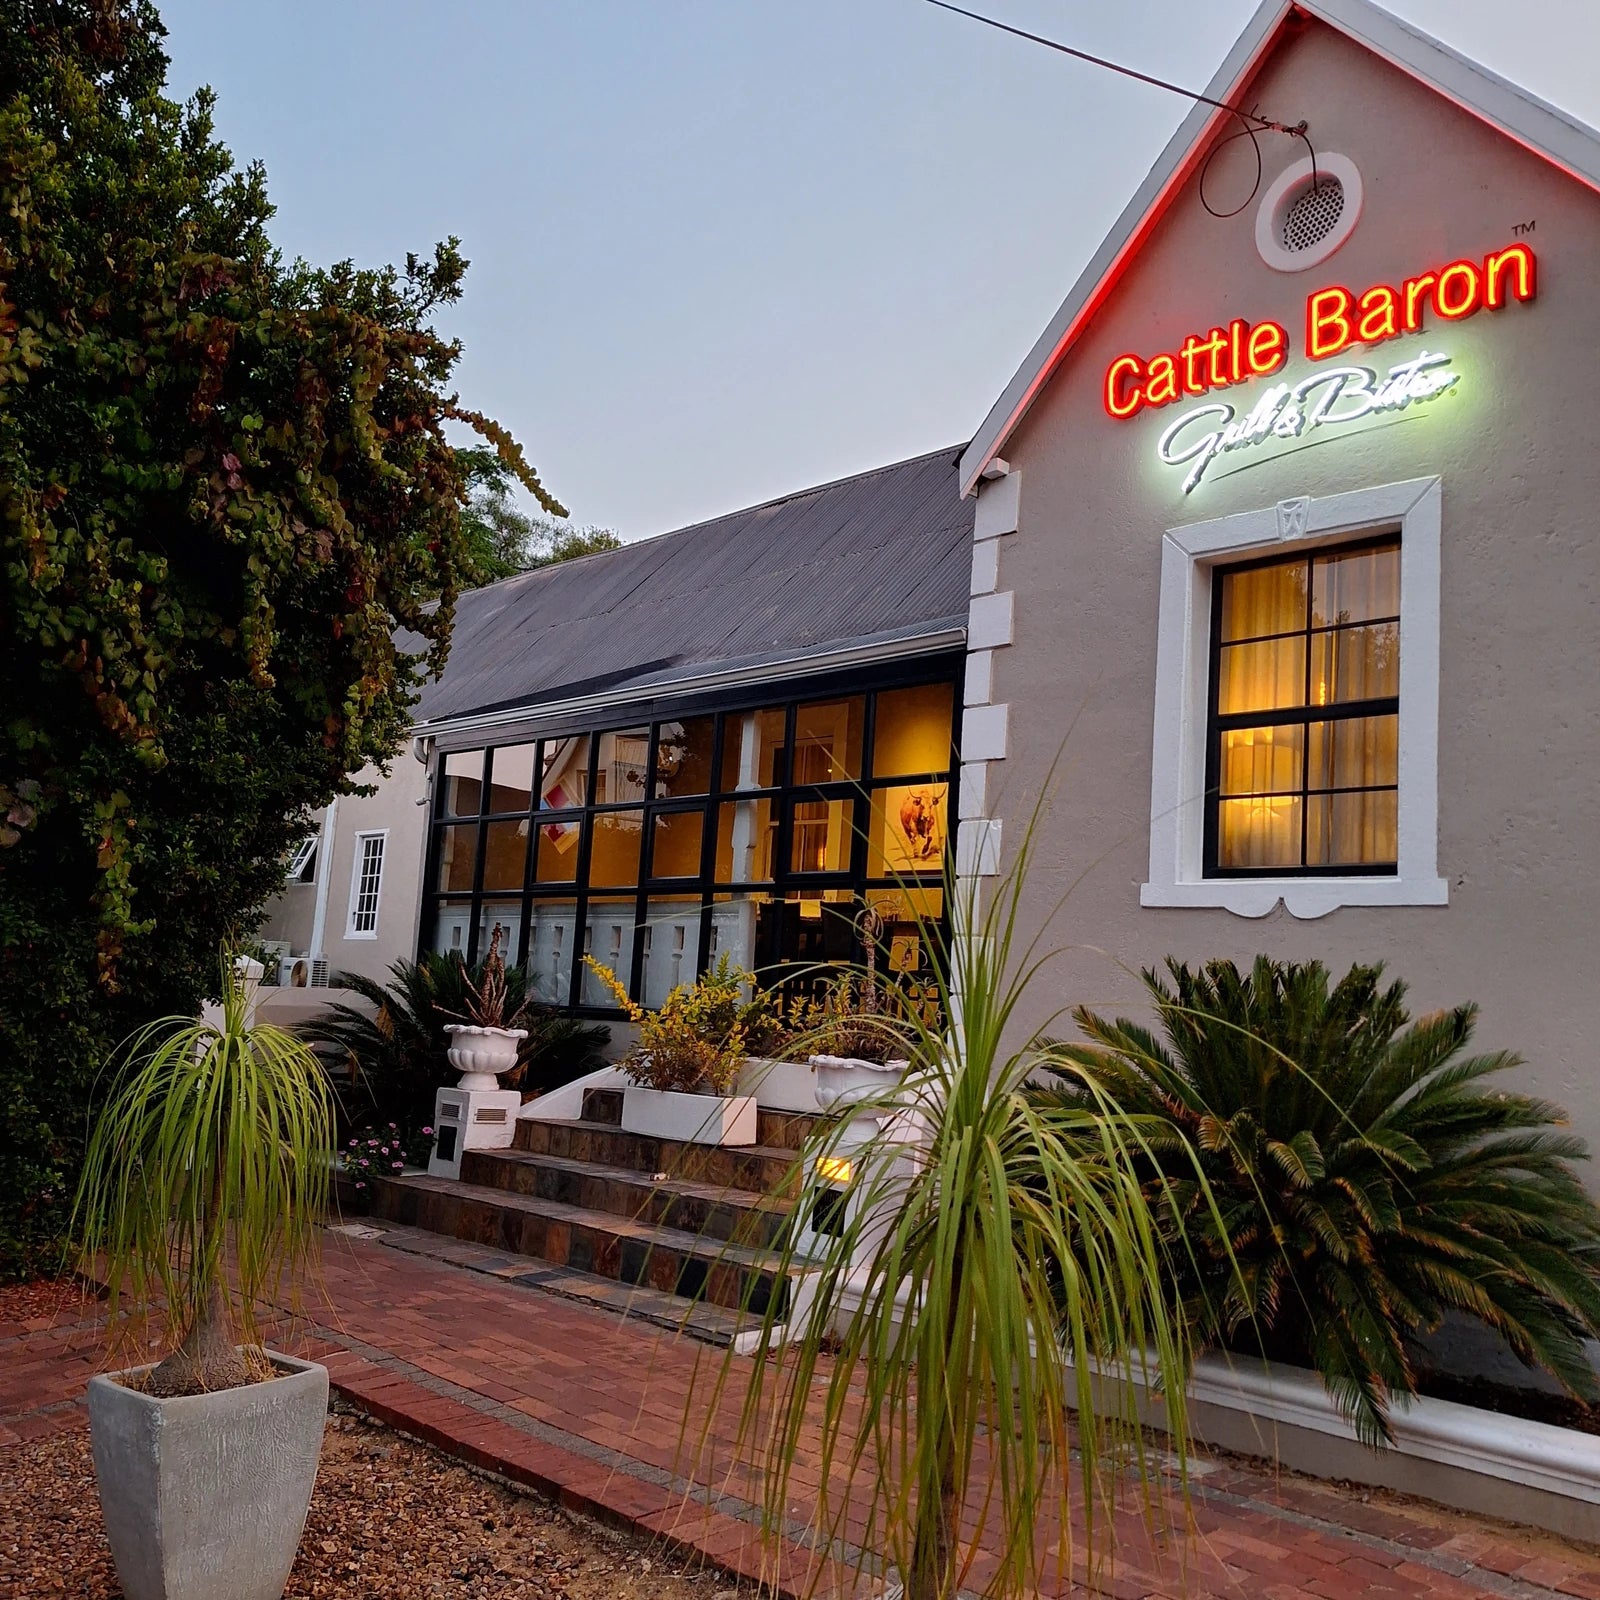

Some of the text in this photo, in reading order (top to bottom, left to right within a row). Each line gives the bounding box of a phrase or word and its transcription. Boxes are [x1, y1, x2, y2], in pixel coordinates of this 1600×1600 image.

[1511, 220, 1536, 237] TM
[1104, 242, 1537, 419] Cattle Baron
